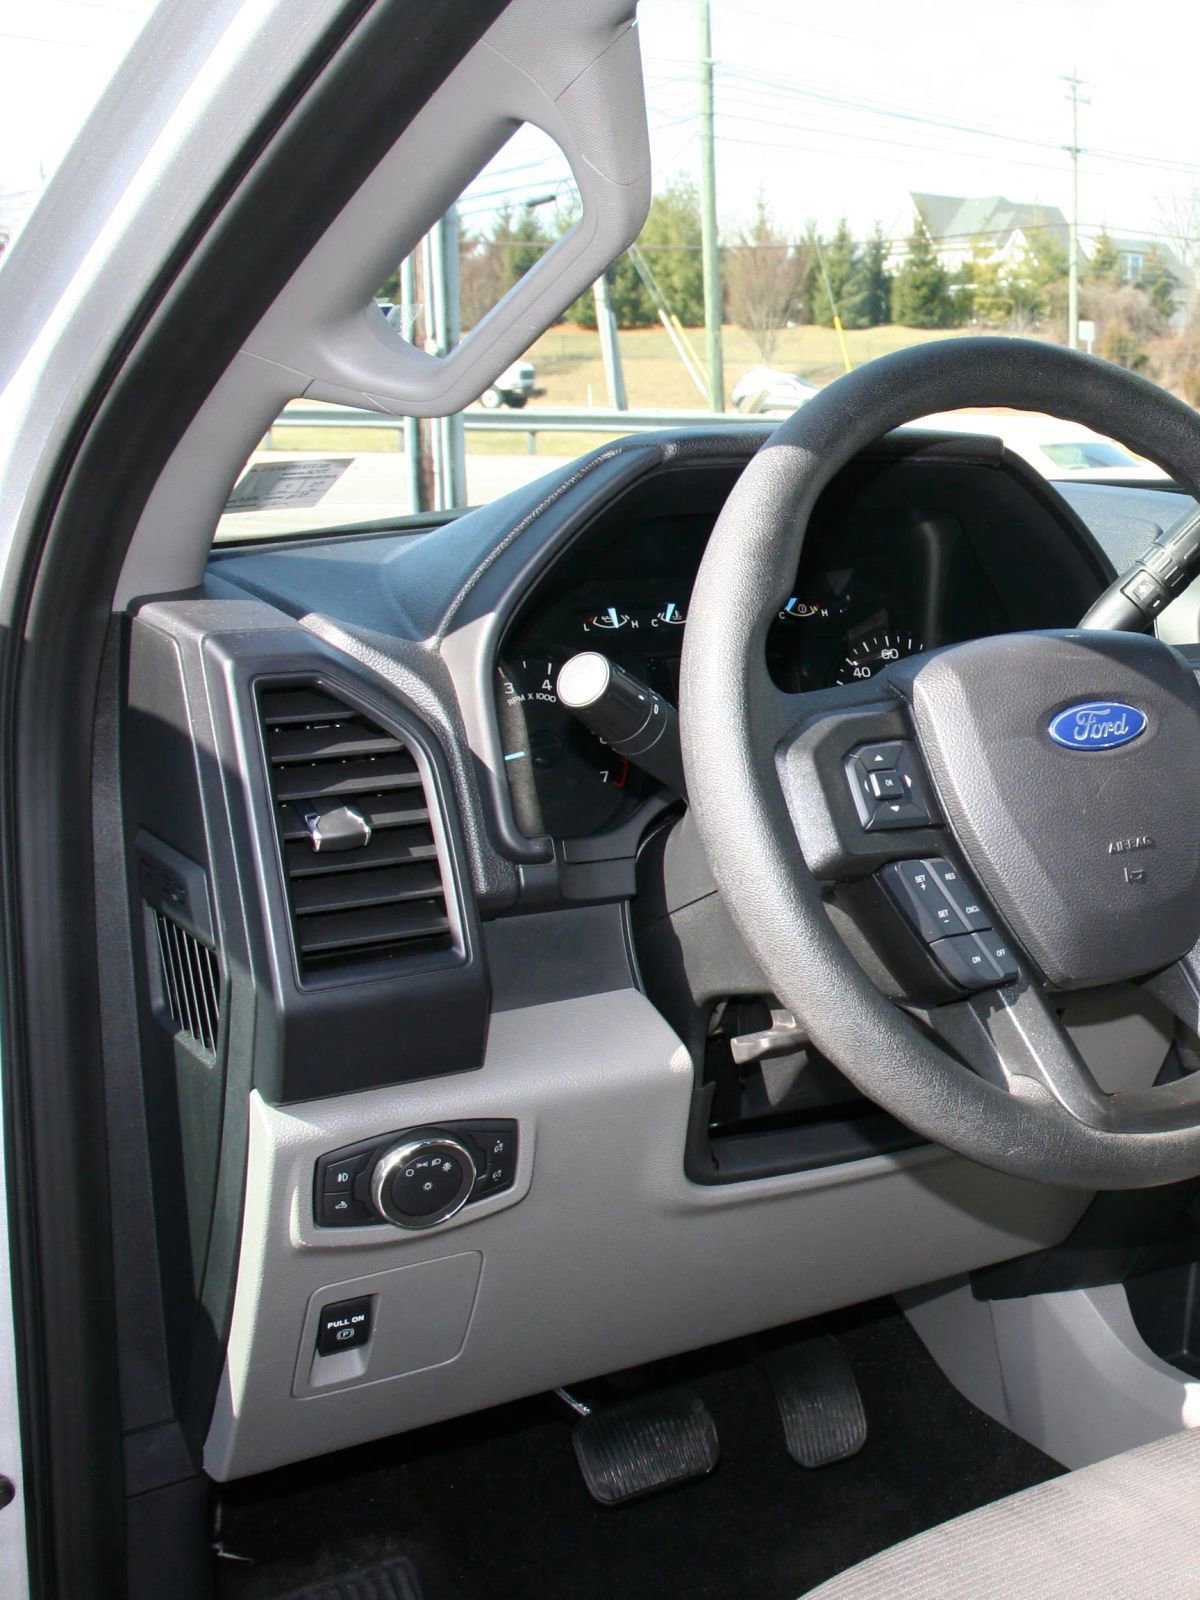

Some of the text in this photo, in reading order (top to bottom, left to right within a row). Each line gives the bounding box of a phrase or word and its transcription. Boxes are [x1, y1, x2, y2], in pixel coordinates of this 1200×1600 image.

[821, 608, 829, 617] H
[583, 623, 590, 632] L
[631, 620, 639, 629] H
[651, 618, 659, 627] C
[853, 667, 871, 678] 40
[503, 681, 515, 695] 3
[541, 679, 552, 691] 4
[535, 693, 557, 703] 1000
[1074, 708, 1129, 741] Ford
[600, 770, 609, 783] 7
[1108, 836, 1152, 854] AIRBAG
[914, 874, 926, 884] SET
[944, 872, 957, 881] RES
[937, 909, 949, 919] SET
[965, 905, 981, 914] CNCL
[996, 948, 1006, 957] OFF
[971, 956, 982, 964] ON
[327, 1314, 365, 1329] PULL ON
